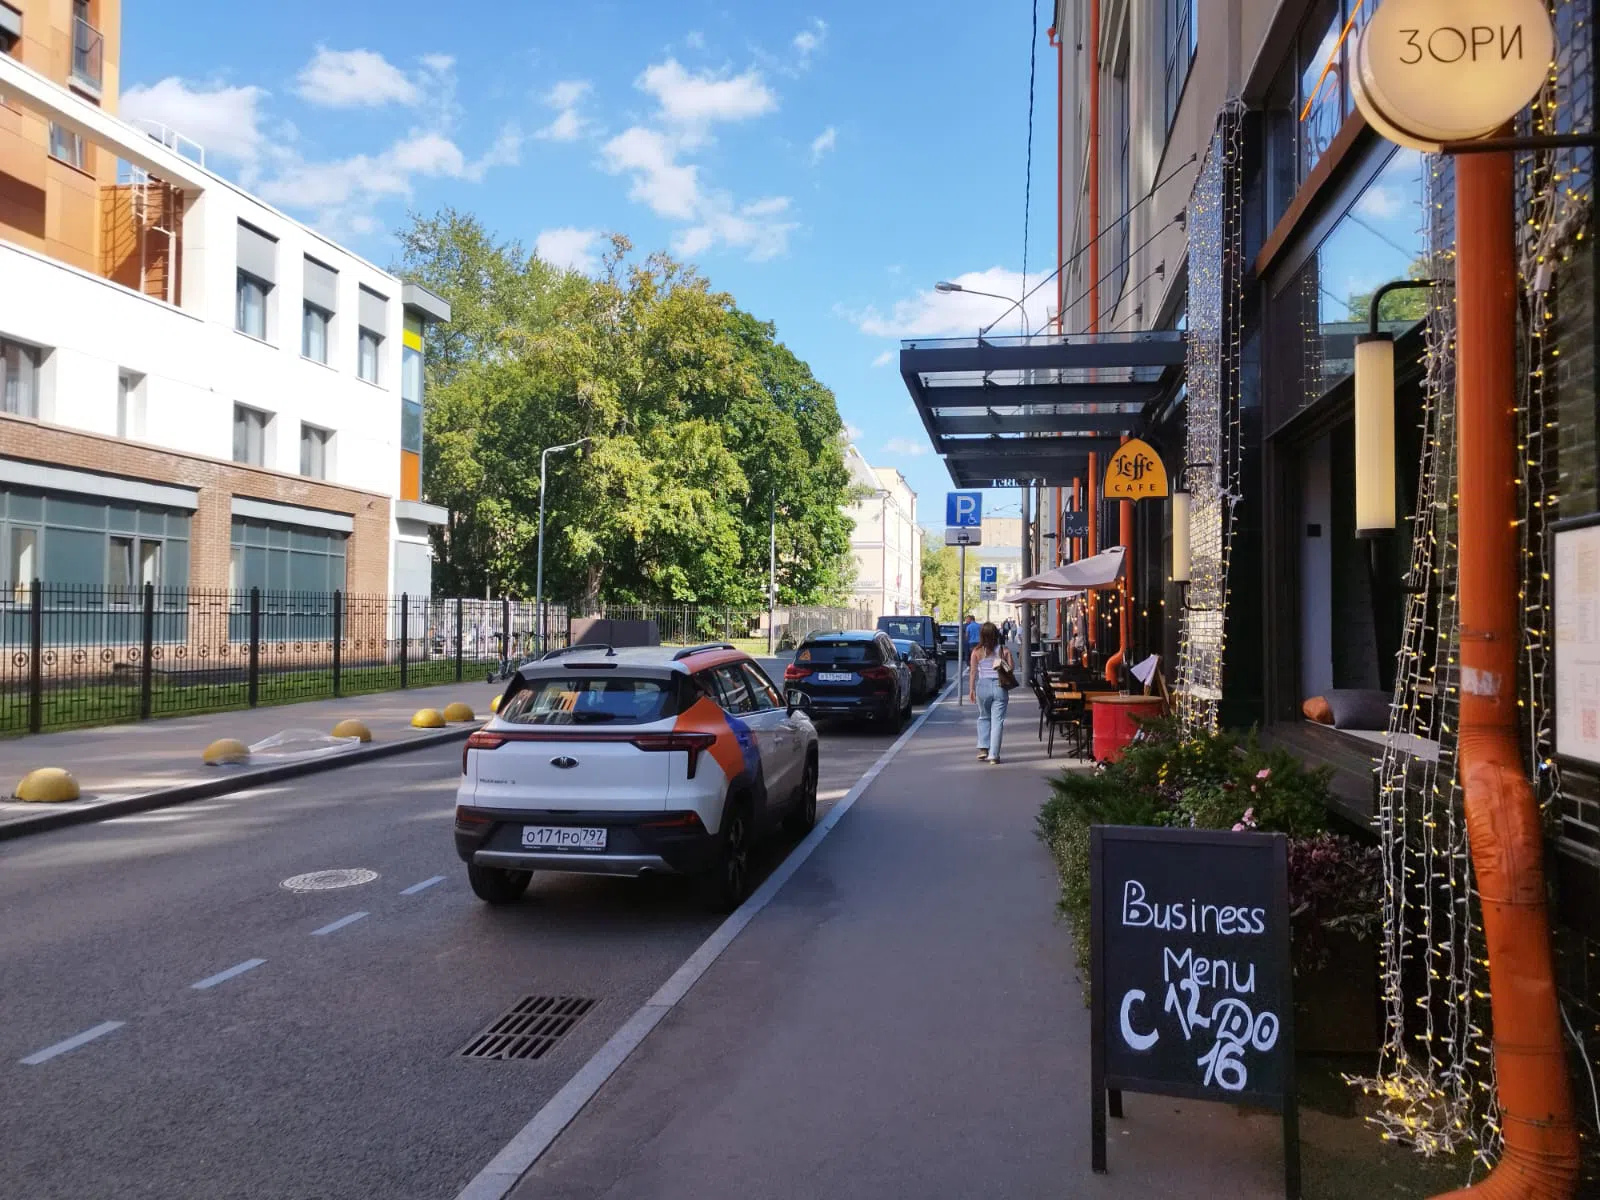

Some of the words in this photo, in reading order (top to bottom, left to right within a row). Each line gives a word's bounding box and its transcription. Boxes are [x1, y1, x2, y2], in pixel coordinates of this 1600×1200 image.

[1399, 24, 1523, 65] ЗОРИ
[1114, 483, 1156, 492] CAFE
[1115, 452, 1154, 481] Leffe
[1122, 879, 1266, 935] Business
[1163, 946, 1256, 993] Menu
[1197, 1040, 1248, 1091] 16
